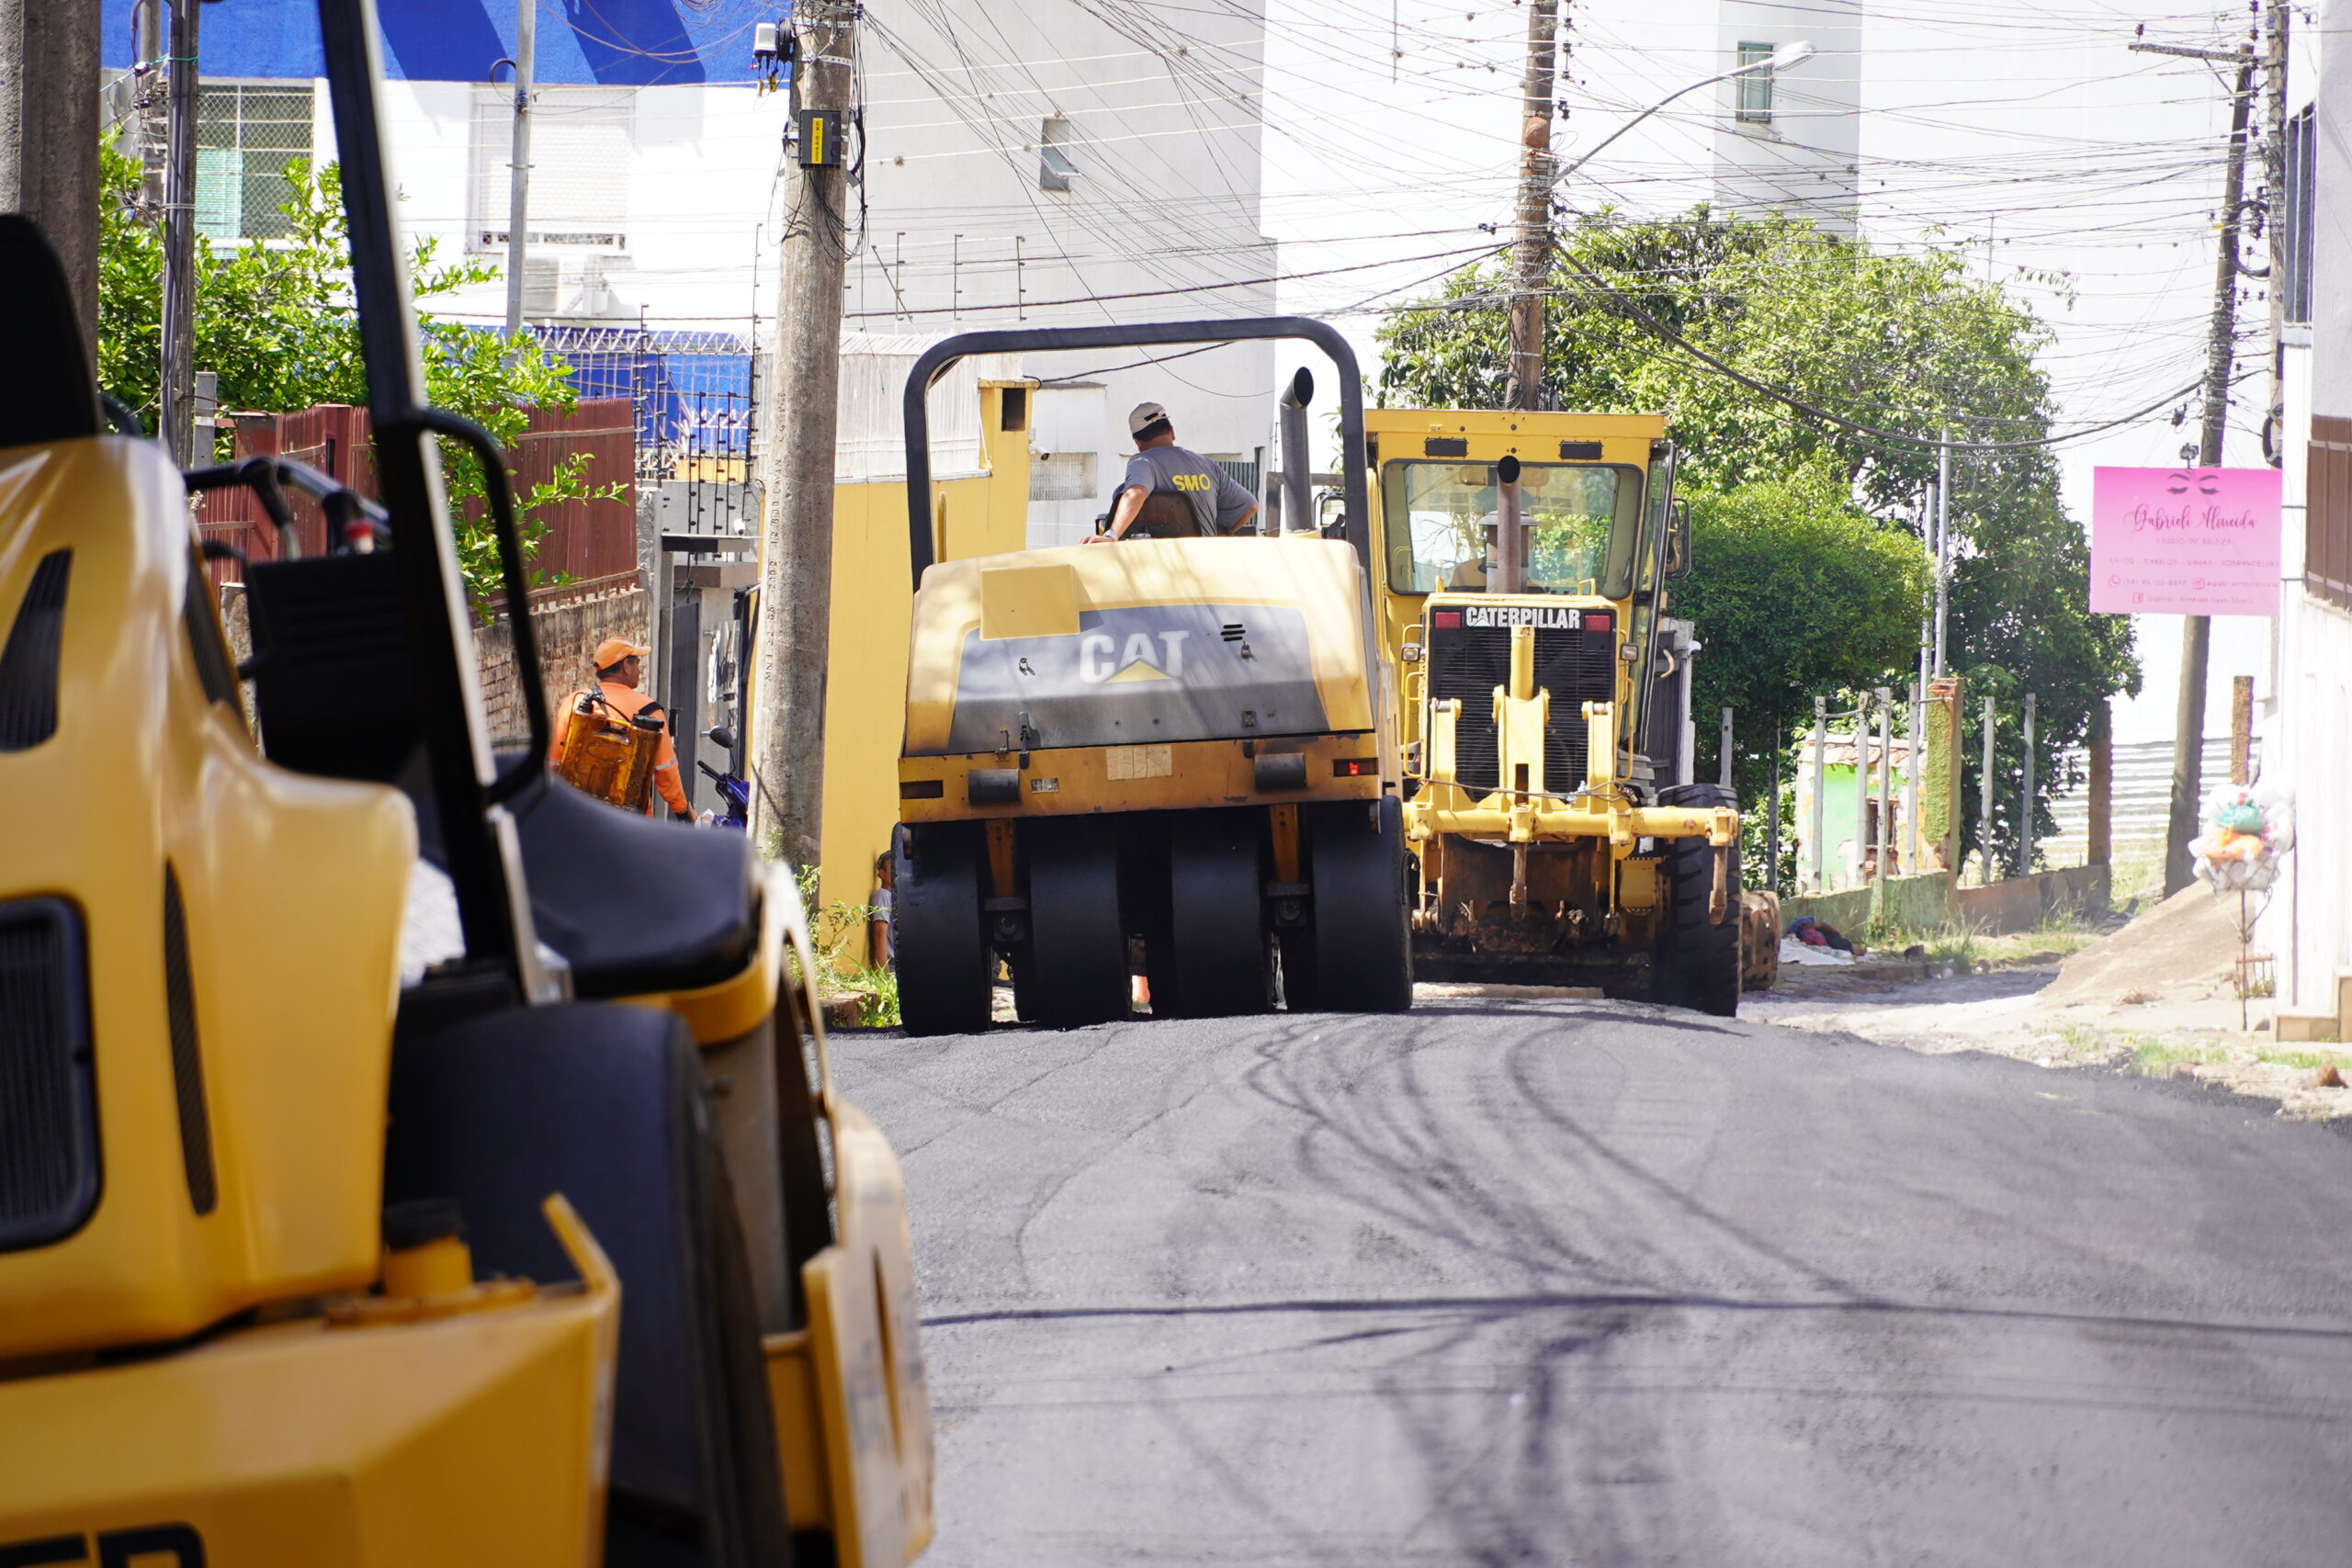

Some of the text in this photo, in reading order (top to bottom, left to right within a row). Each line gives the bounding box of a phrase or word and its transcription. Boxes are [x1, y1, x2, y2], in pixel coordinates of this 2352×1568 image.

[1172, 473, 1211, 491] SMO
[2197, 505, 2256, 529] Almeida
[1465, 607, 1580, 629] CATERPILLAR
[1080, 630, 1190, 683] CAT
